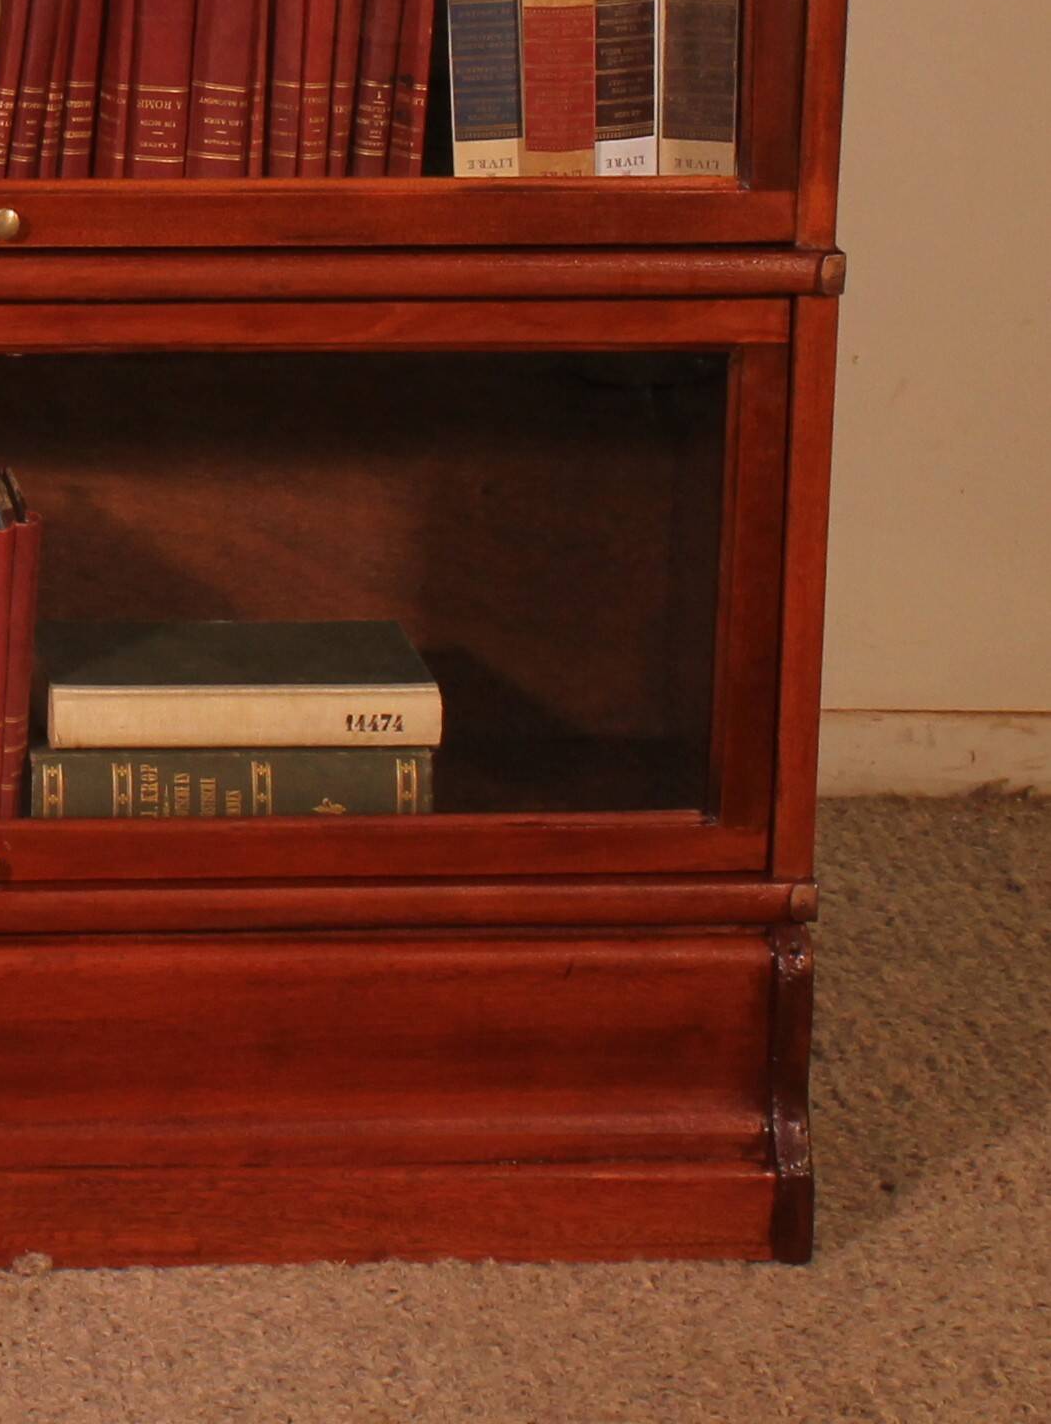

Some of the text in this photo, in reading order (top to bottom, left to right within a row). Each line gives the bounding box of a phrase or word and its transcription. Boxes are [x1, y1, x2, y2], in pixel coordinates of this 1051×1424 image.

[466, 157, 514, 171] LIVRE
[604, 155, 646, 169] LIVRE
[673, 156, 720, 171] LIVRE
[344, 713, 406, 733] 14474
[140, 764, 158, 802] KROP
